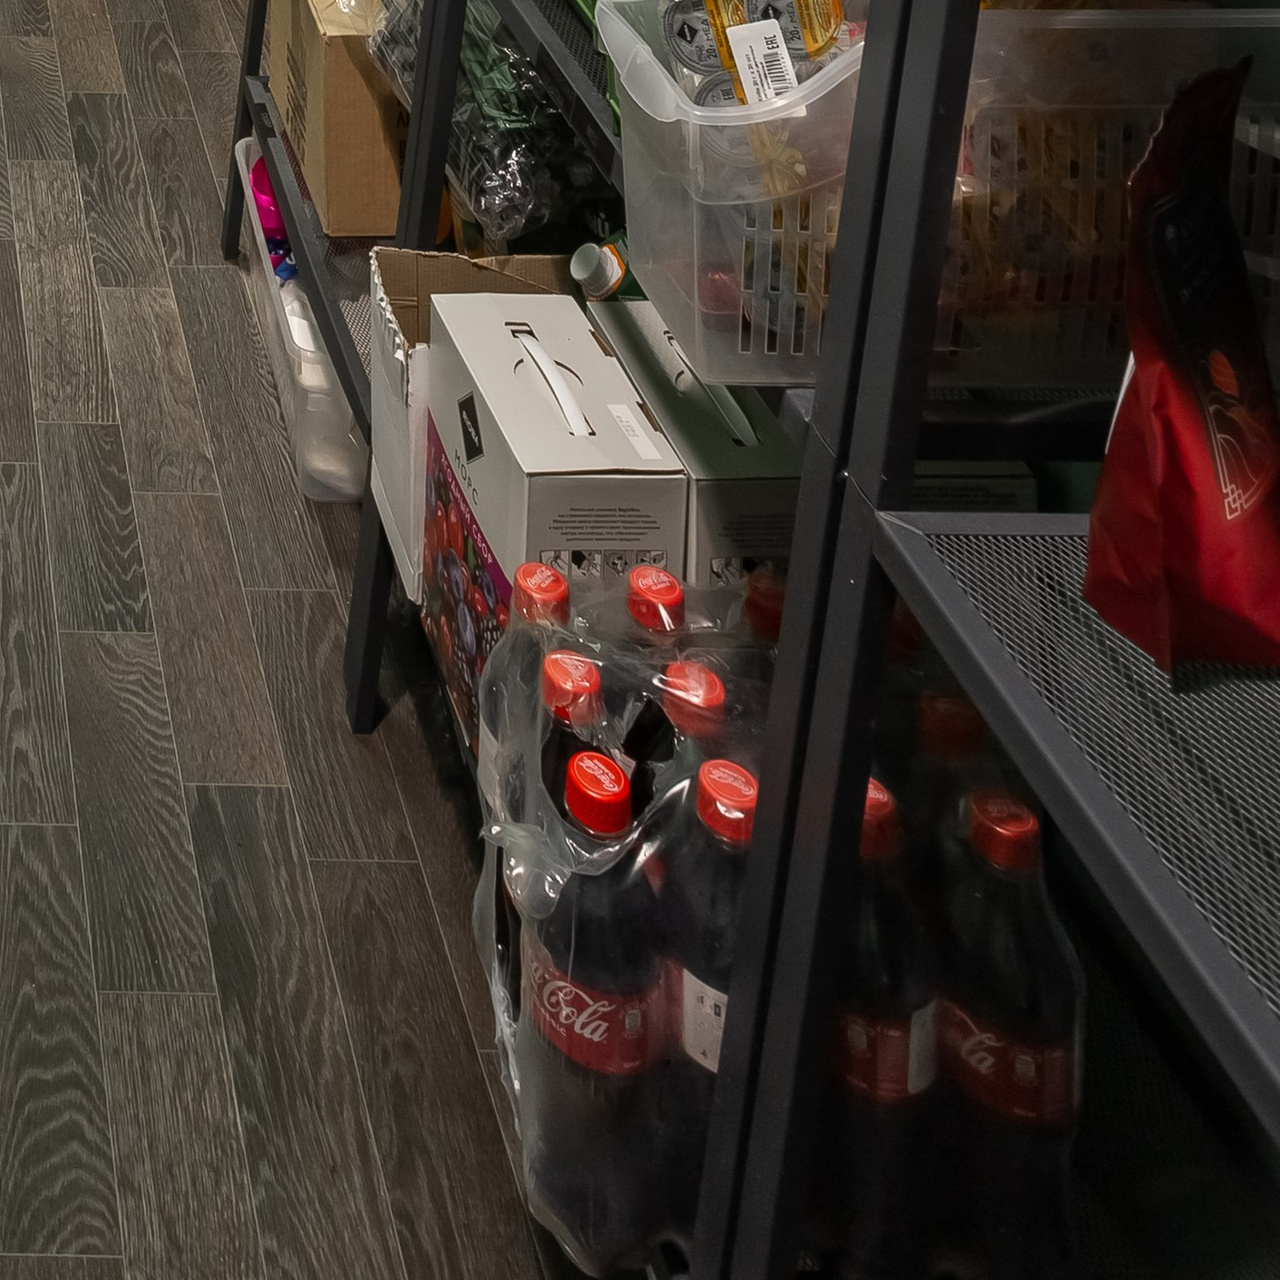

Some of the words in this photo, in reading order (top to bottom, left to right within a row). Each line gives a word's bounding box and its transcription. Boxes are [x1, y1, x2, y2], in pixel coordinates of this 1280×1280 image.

[786, 1, 797, 23] МЕД
[701, 18, 711, 42] МЕД
[789, 29, 801, 41] 20
[706, 47, 717, 59] 20
[763, 33, 779, 51] EAC
[454, 449, 478, 506] МОРС
[472, 524, 493, 564] СБОР
